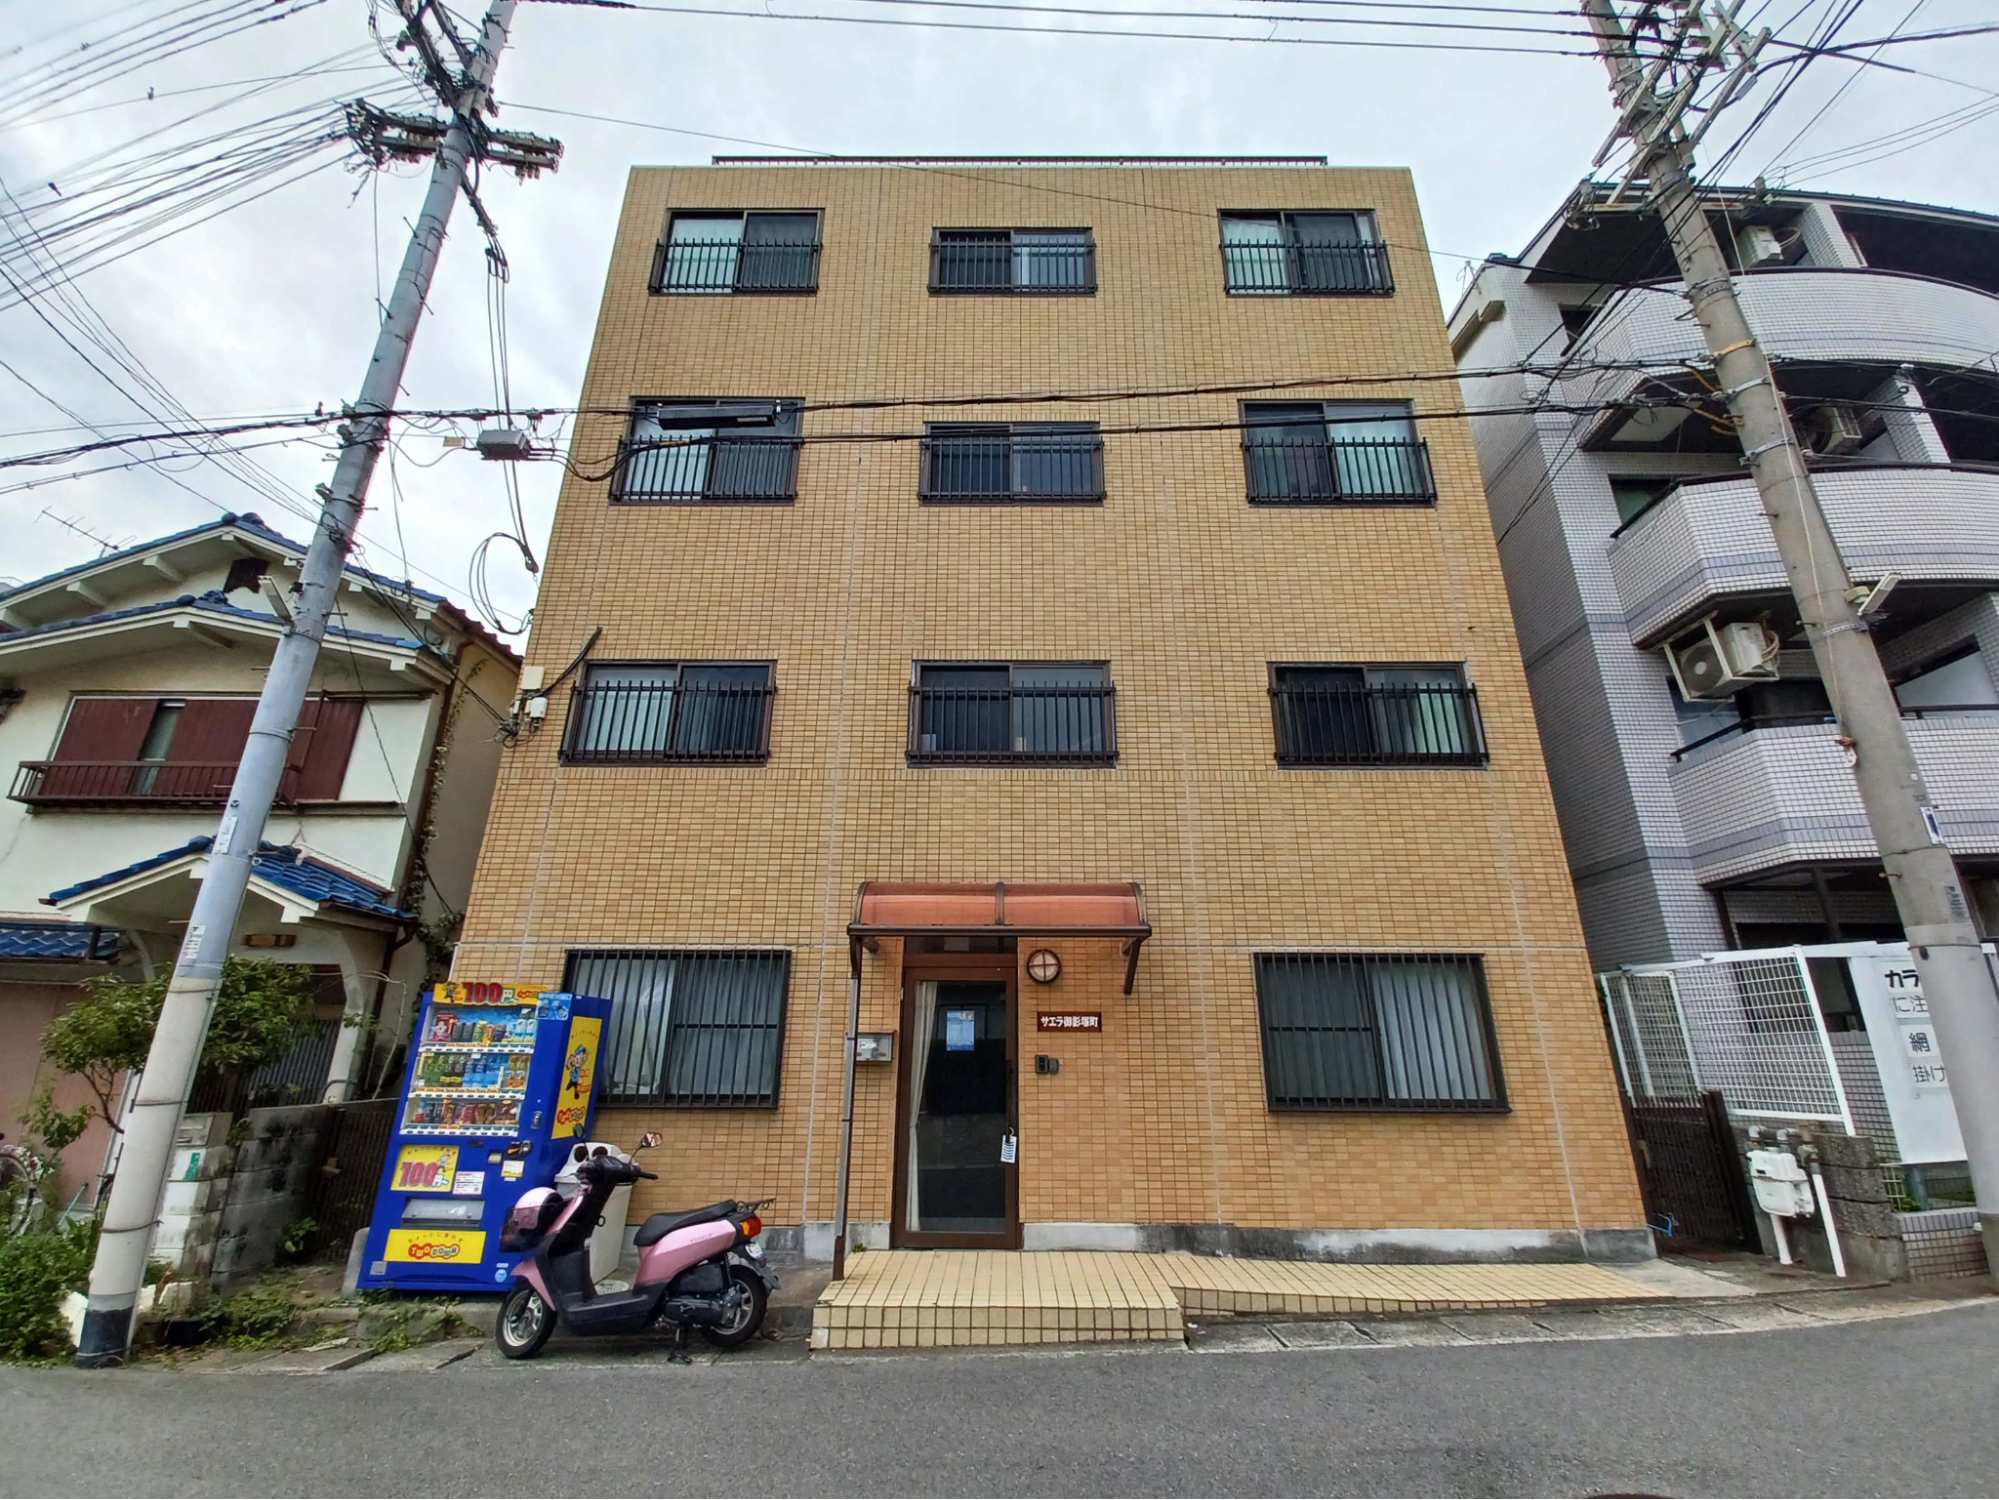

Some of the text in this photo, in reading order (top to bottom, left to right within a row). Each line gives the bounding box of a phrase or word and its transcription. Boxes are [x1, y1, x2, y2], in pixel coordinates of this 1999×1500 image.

[1040, 1015, 1099, 1028] サエラ御影塚町
[1908, 1031, 1932, 1053] 網
[1912, 1064, 1946, 1083] 掛け
